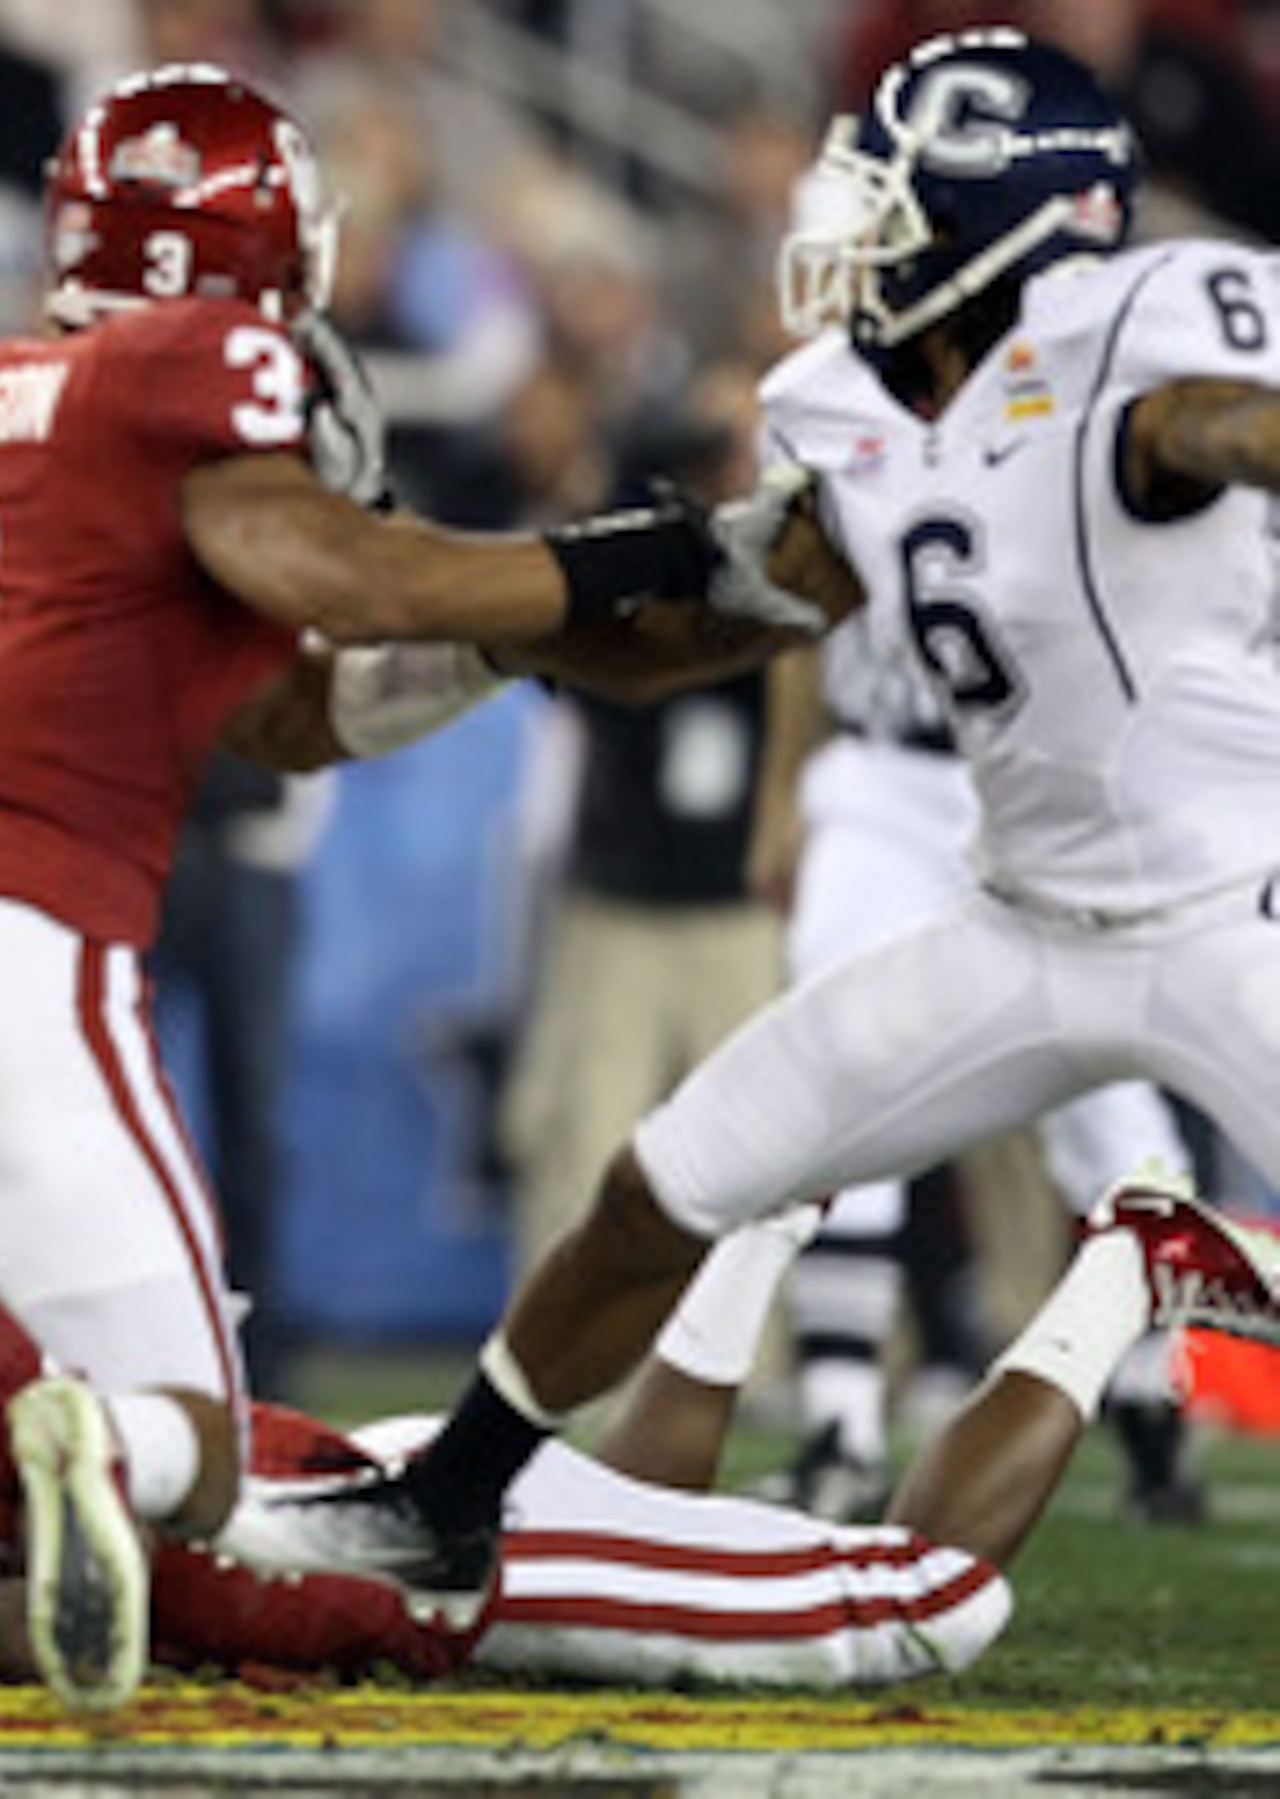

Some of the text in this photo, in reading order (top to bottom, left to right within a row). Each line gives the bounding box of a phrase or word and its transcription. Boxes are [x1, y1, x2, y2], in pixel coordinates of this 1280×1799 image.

[141, 228, 194, 297] 3
[1207, 268, 1267, 352] 6
[223, 323, 303, 446] 3
[896, 510, 1024, 712] 6
